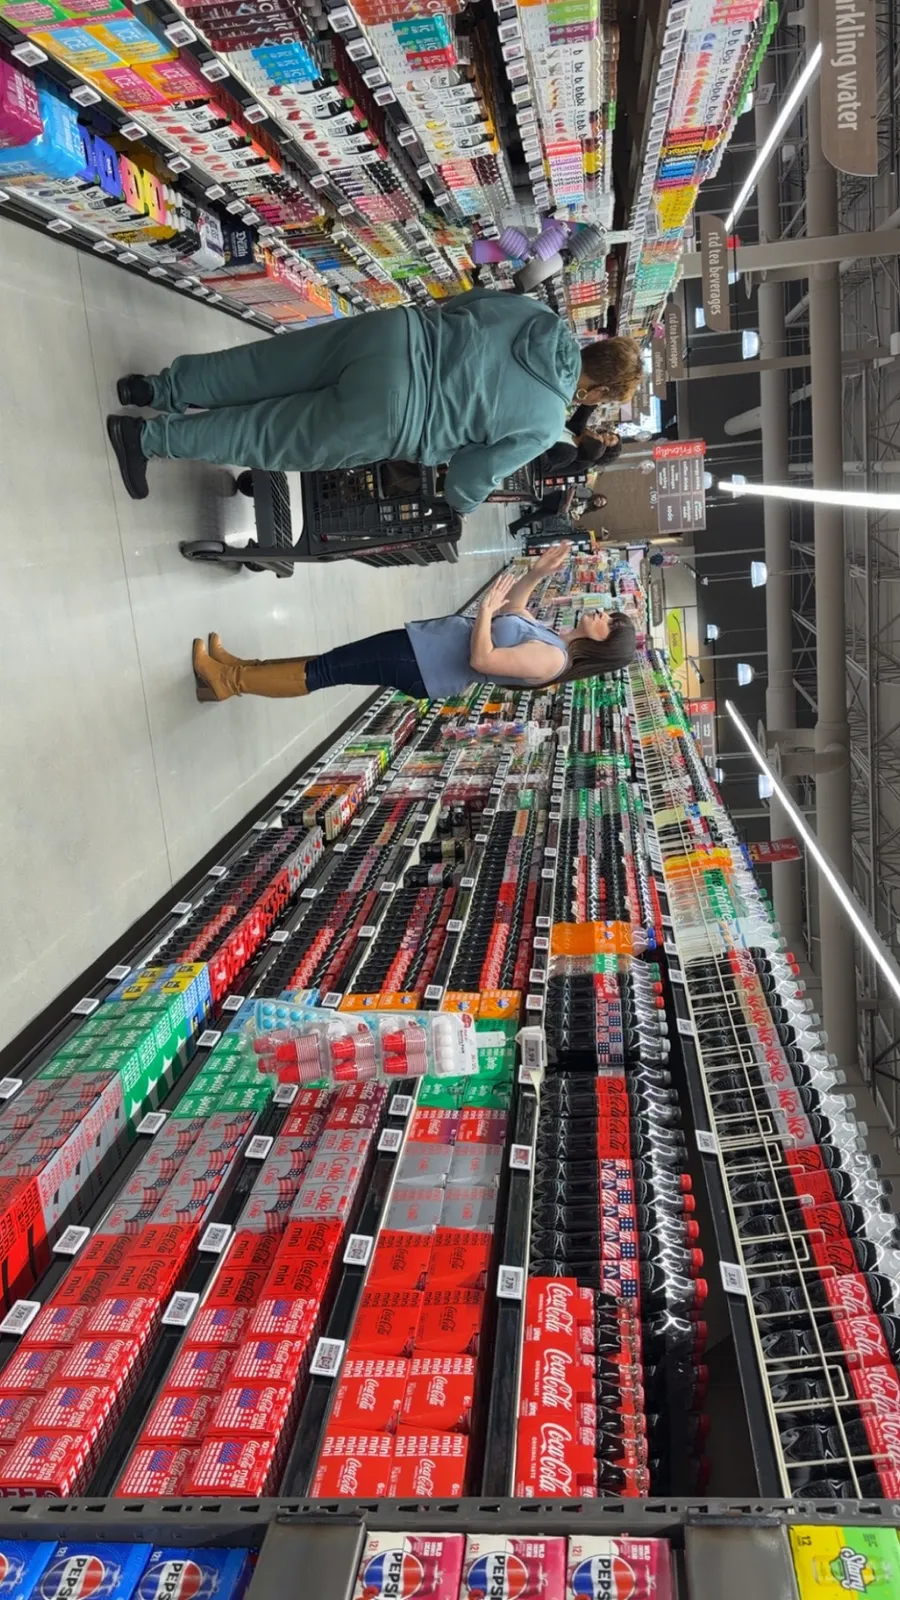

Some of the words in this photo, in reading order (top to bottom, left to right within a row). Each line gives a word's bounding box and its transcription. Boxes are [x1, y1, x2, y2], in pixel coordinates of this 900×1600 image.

[64, 36, 86, 49] ICE
[116, 29, 137, 42] ICE
[829, 0, 866, 68] rkling
[112, 76, 133, 88] ICE
[162, 68, 180, 80] ICE
[837, 71, 861, 130] water
[232, 231, 246, 258] Death
[708, 232, 722, 246] rtd
[710, 248, 722, 264] tea
[706, 268, 724, 315] beverages
[668, 313, 677, 324] rtd
[669, 326, 677, 336] tea
[668, 336, 679, 368] beverages
[655, 369, 664, 385] drinks
[656, 446, 692, 457] Friendly
[101, 1050, 125, 1069] Sprite
[209, 1074, 228, 1093] Sprite
[346, 1084, 357, 1096] mini
[195, 1096, 216, 1116] Sprite
[240, 1088, 259, 1108] Sprite
[300, 1092, 312, 1106] mini
[336, 1108, 348, 1121] mini
[288, 1118, 302, 1132] mini
[325, 1134, 336, 1148] mini
[338, 1130, 360, 1152] Coke
[314, 1162, 328, 1176] mini
[327, 1158, 350, 1180] Coke
[302, 1190, 316, 1208] mini
[316, 1186, 338, 1210] Coke
[140, 1230, 157, 1248] mini
[288, 1228, 302, 1246] mini
[86, 1240, 104, 1259] mini
[232, 1240, 250, 1258] mini
[118, 1266, 138, 1286] mini
[273, 1265, 290, 1286] mini
[62, 1276, 81, 1296] mini
[216, 1277, 236, 1298] mini
[176, 1298, 188, 1310] 7.99
[362, 1292, 372, 1307] mini
[392, 1292, 400, 1307] mini
[412, 1292, 420, 1307] mini
[15, 1306, 28, 1319] 7.99
[850, 1320, 887, 1358] Cola
[342, 1360, 353, 1378] mini
[353, 1360, 364, 1378] mini
[364, 1360, 374, 1378] mini
[374, 1360, 384, 1378] mini
[384, 1360, 395, 1378] mini
[396, 1360, 406, 1378] mini
[410, 1358, 422, 1374] mini
[422, 1358, 432, 1374] mini
[432, 1358, 442, 1374] mini
[442, 1358, 452, 1374] mini
[452, 1358, 463, 1374] mini
[463, 1358, 474, 1374] mini
[74, 1412, 86, 1428] mini
[249, 1414, 258, 1429] cans
[256, 1413, 267, 1430] mini
[322, 1436, 334, 1456] mini
[334, 1436, 345, 1456] mini
[346, 1436, 356, 1456] mini
[357, 1436, 368, 1456] mini
[368, 1436, 380, 1456] mini
[380, 1436, 391, 1456] mini
[395, 1436, 406, 1456] mini
[406, 1436, 417, 1456] mini
[418, 1436, 429, 1456] mini
[429, 1436, 440, 1456] mini
[441, 1436, 452, 1456] mini
[452, 1436, 464, 1456] mini
[530, 1437, 538, 1460] ORIGINAL
[37, 1463, 48, 1480] cans
[44, 1462, 57, 1480] mini
[230, 1470, 240, 1488] cans
[236, 1470, 248, 1488] mini
[339, 1458, 362, 1496] Coca-Cola
[416, 1458, 436, 1497] Coca-Cola
[166, 1476, 178, 1495] mini
[368, 1540, 378, 1548] 12
[801, 1536, 812, 1546] 12
[596, 1558, 612, 1600] PEPS
[840, 1548, 867, 1593] Starry
[157, 1563, 184, 1600] PEPS
